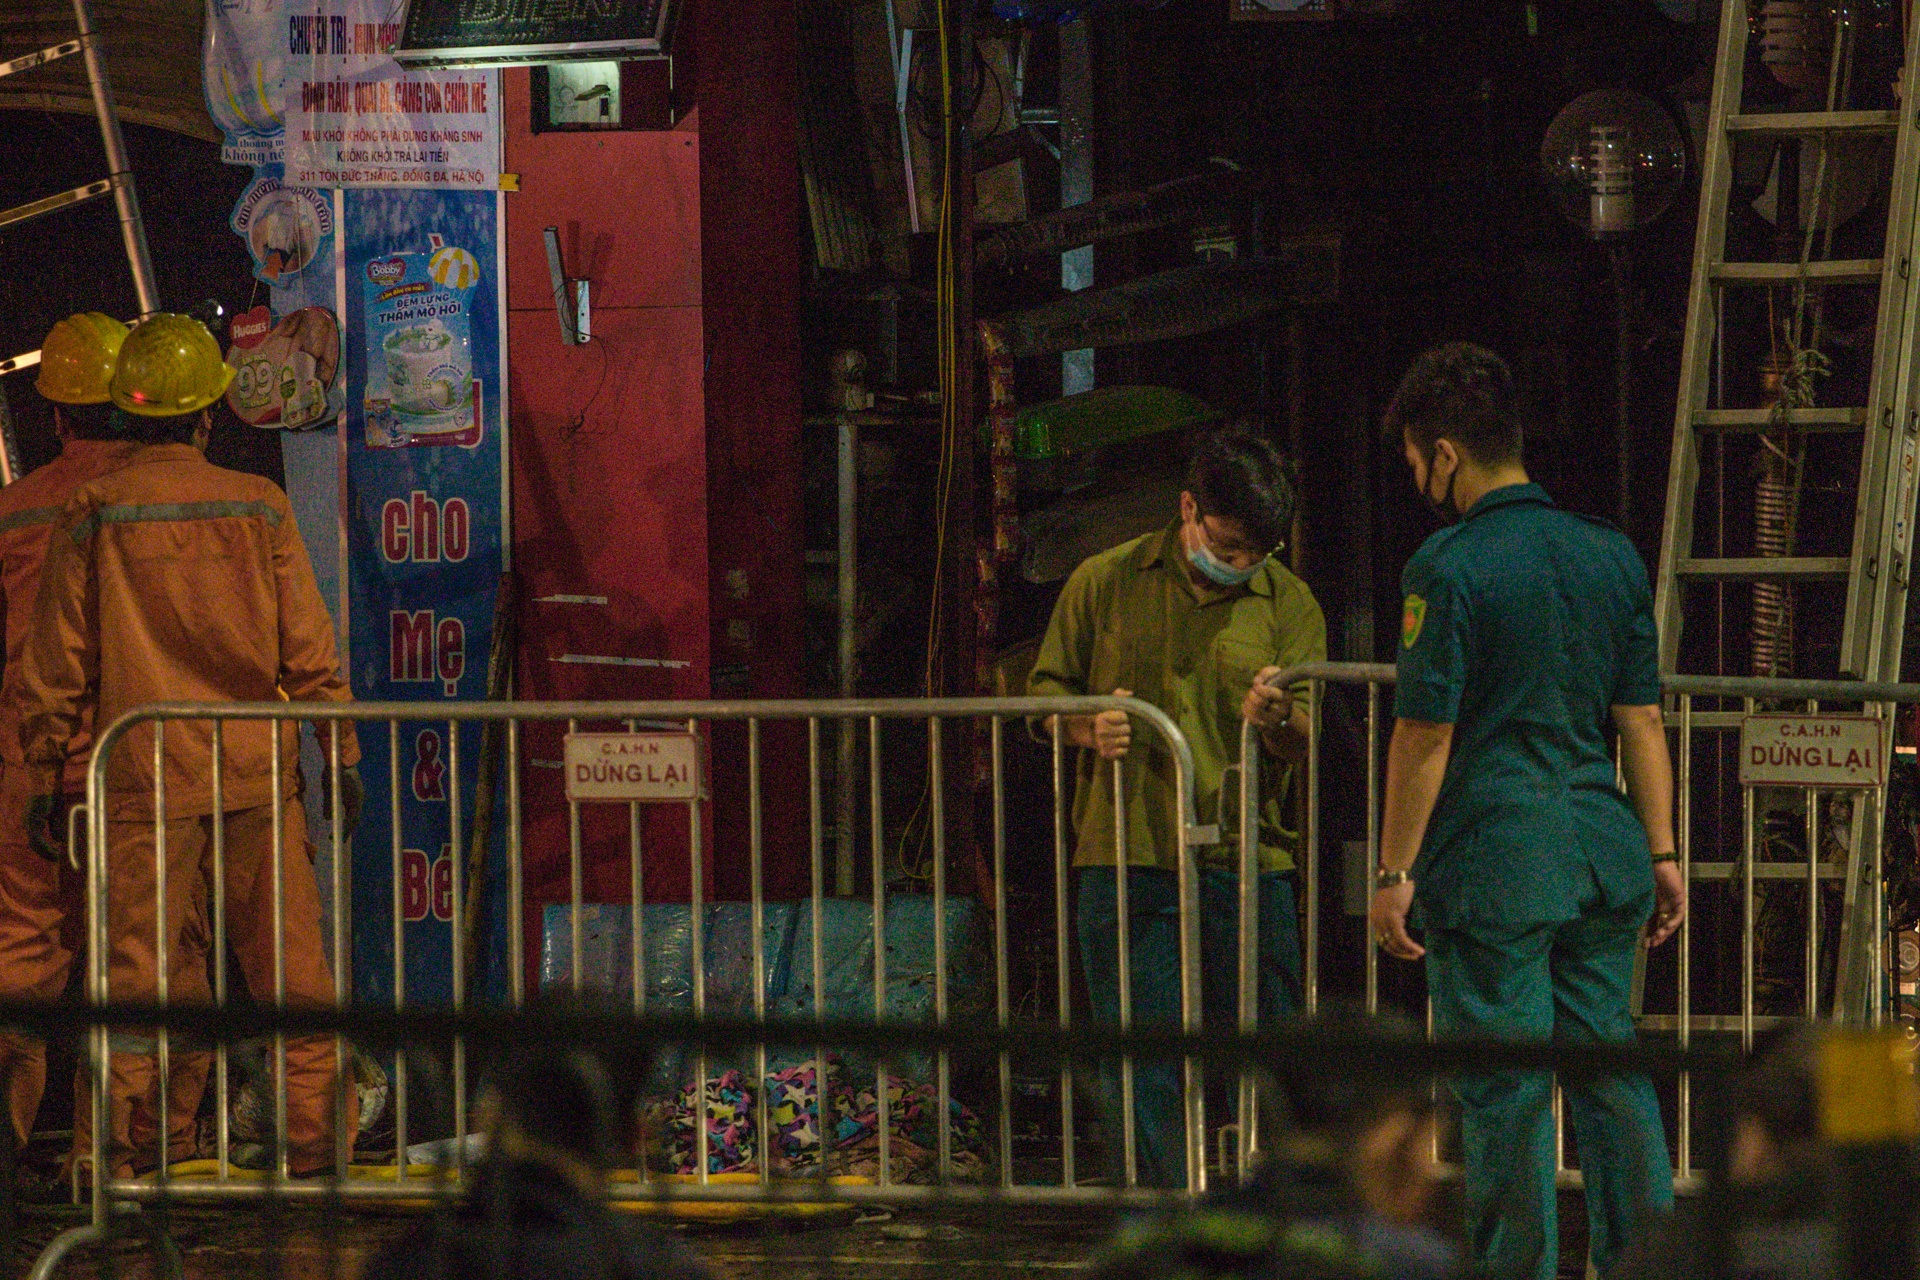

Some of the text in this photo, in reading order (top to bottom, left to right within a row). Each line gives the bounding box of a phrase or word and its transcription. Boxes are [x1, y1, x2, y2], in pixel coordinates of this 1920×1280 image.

[302, 82, 325, 113] ĐINH
[444, 75, 468, 113] CHÍN
[461, 130, 483, 142] SINH
[300, 170, 316, 181] 311
[371, 261, 404, 277] Bobby
[382, 490, 470, 563] cho
[389, 609, 465, 697] Mẹ
[412, 728, 447, 802] &
[1751, 739, 1873, 773] DỪNG LẠI
[647, 763, 688, 788] LẠI
[402, 843, 452, 922] Bé
